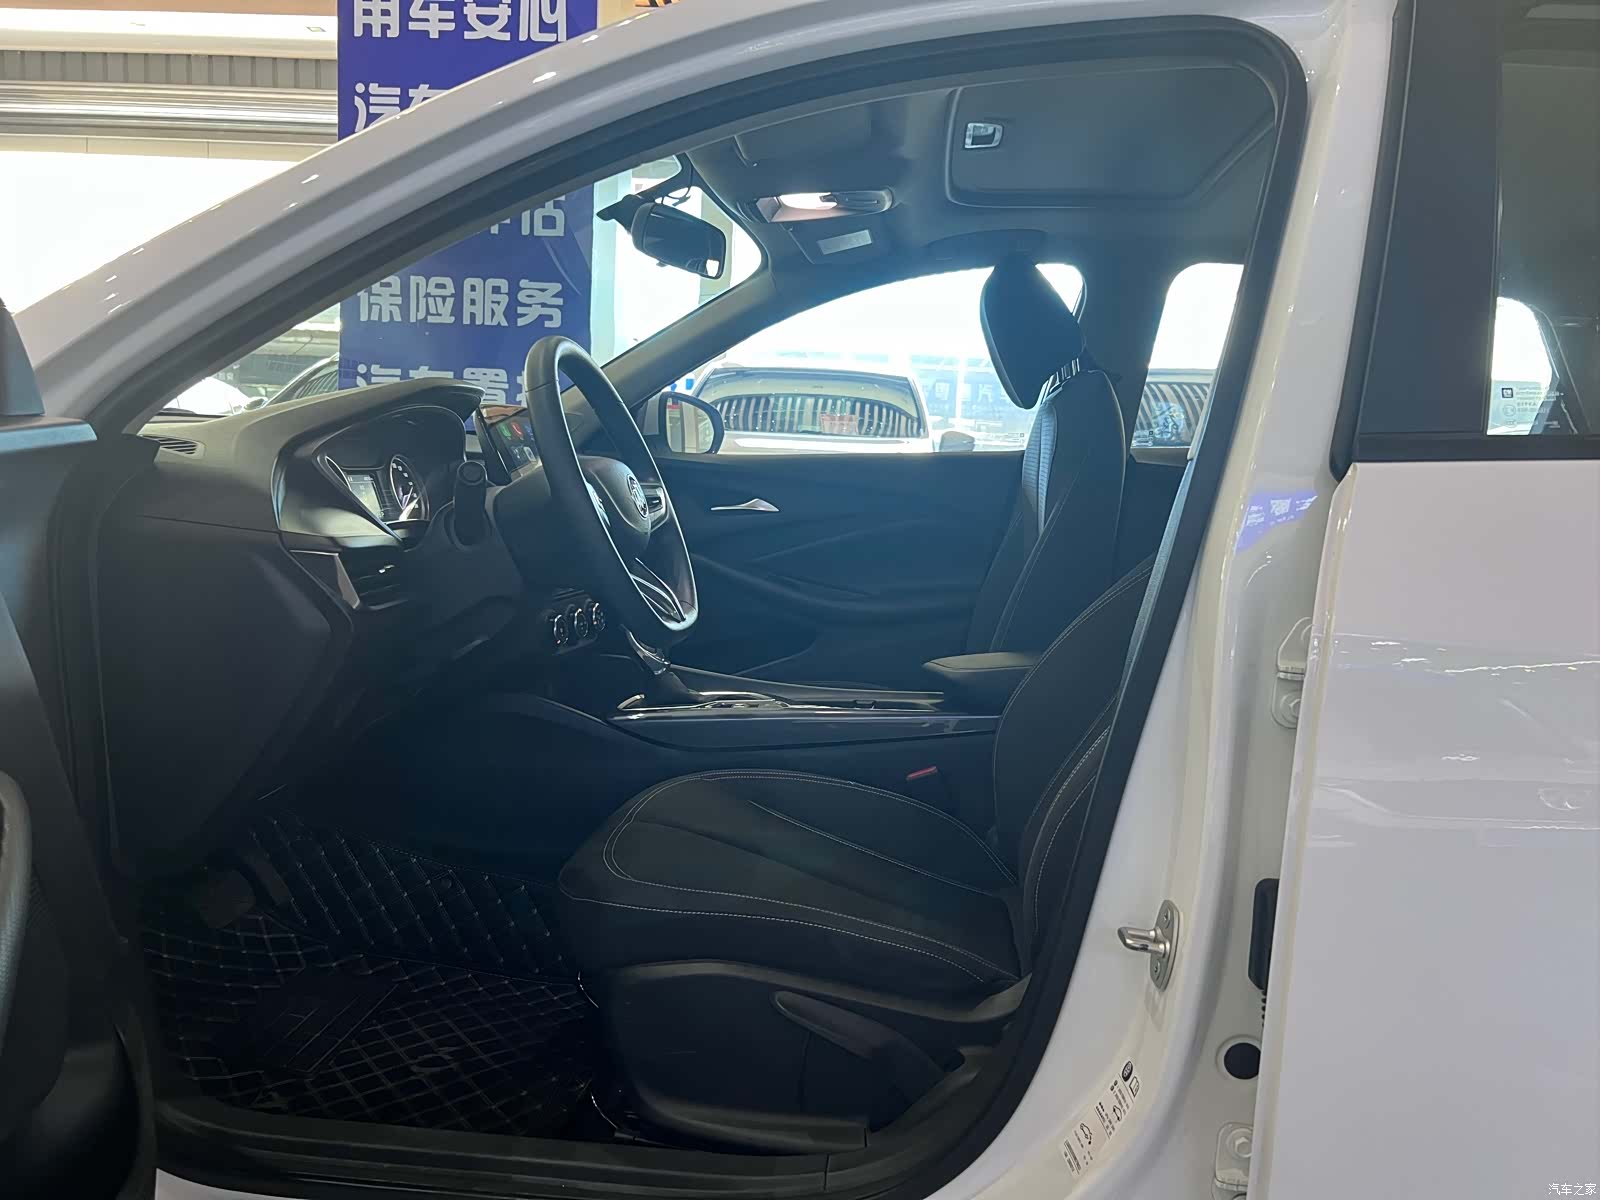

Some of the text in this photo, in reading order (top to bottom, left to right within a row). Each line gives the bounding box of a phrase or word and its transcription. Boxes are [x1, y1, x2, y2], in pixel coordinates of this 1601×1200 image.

[353, 0, 567, 42] 用车安心
[357, 275, 564, 328] 保险服务
